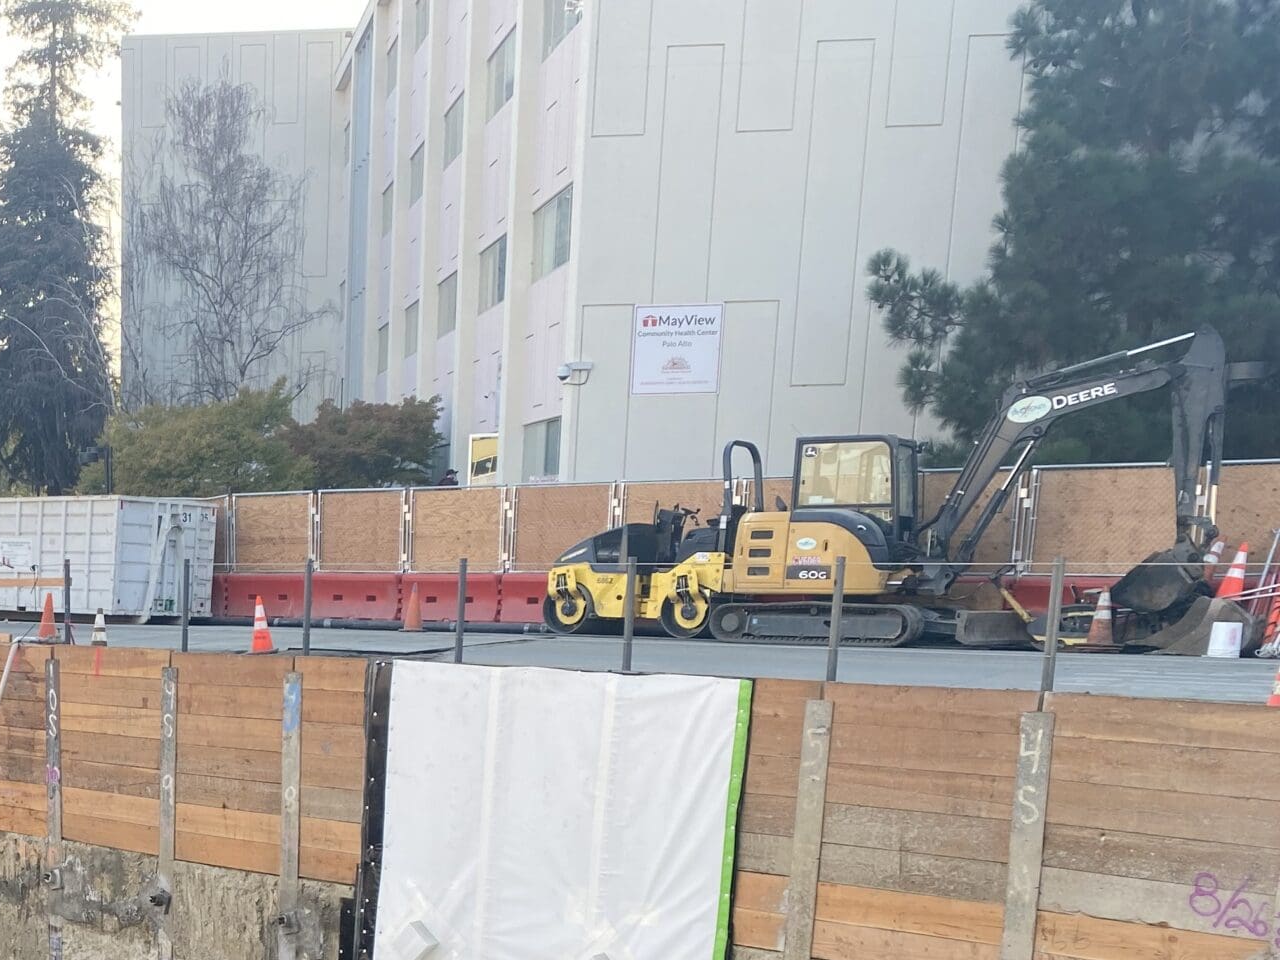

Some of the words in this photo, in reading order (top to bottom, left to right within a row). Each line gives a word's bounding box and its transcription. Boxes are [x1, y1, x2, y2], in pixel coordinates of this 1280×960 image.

[658, 314, 716, 328] MayView
[1052, 382, 1119, 410] DEERE
[798, 570, 827, 579] 60G
[1189, 871, 1270, 937] 8/26
